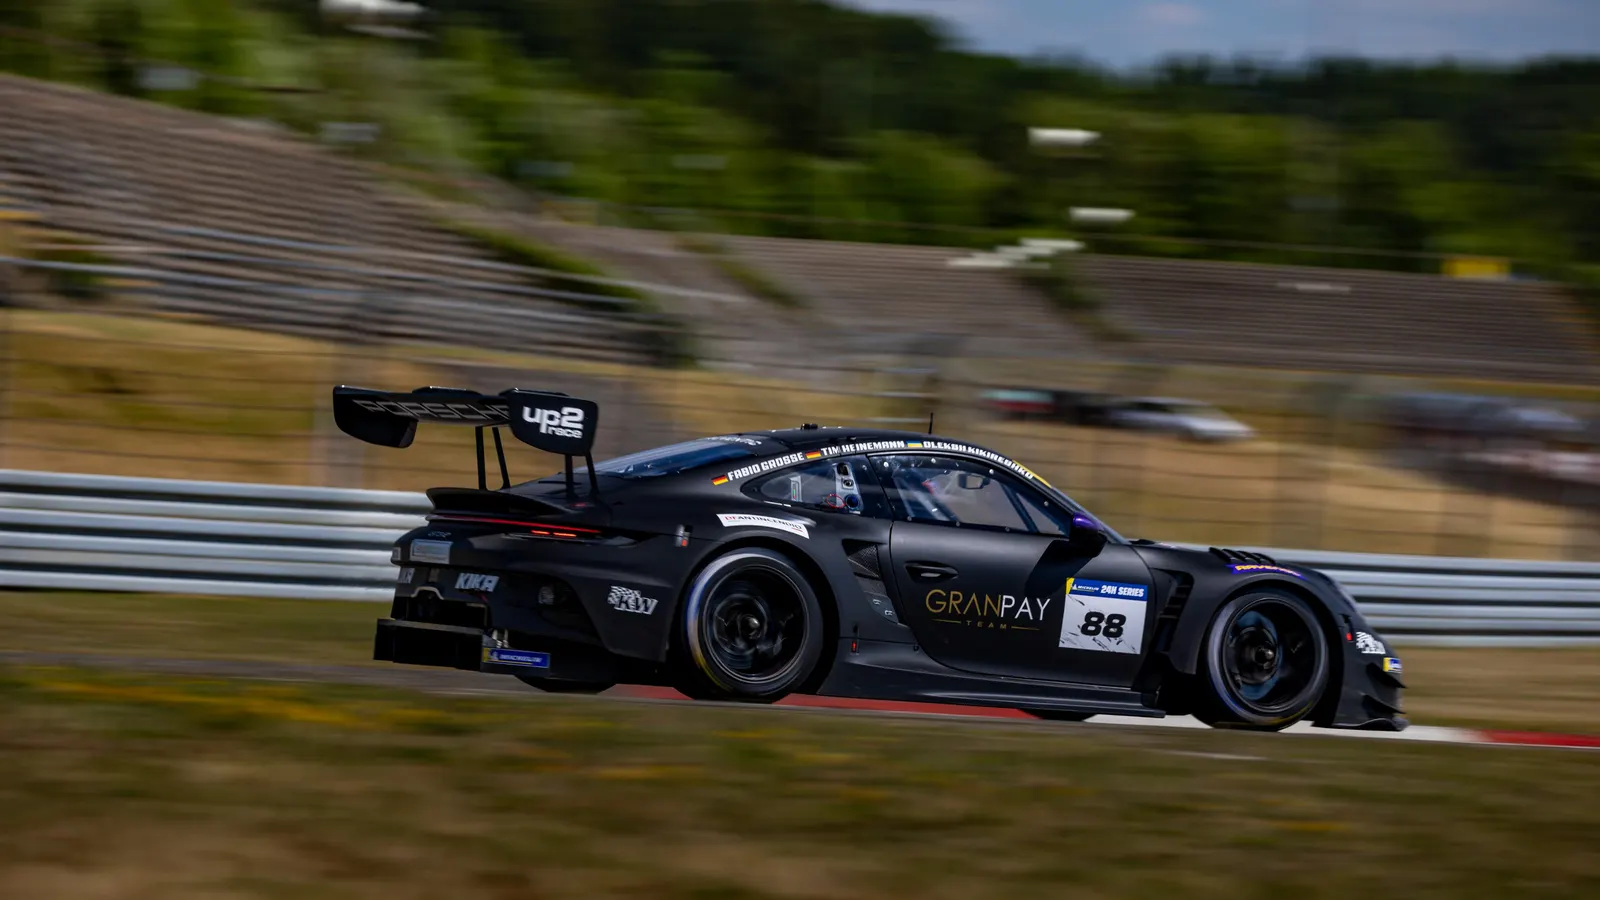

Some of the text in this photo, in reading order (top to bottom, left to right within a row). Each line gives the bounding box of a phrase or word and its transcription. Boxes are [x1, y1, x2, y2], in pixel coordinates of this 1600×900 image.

[522, 406, 584, 434] up2
[547, 426, 583, 439] race
[821, 440, 905, 456] TIM HEINEMANN
[727, 452, 805, 481] FABIO GROSSE
[455, 572, 500, 592] KIKA
[1100, 584, 1117, 595] 24H
[1117, 586, 1144, 598] SERIES
[925, 588, 1051, 621] GRANPAY
[966, 620, 1007, 630] TEAM
[1080, 611, 1127, 639] 88
